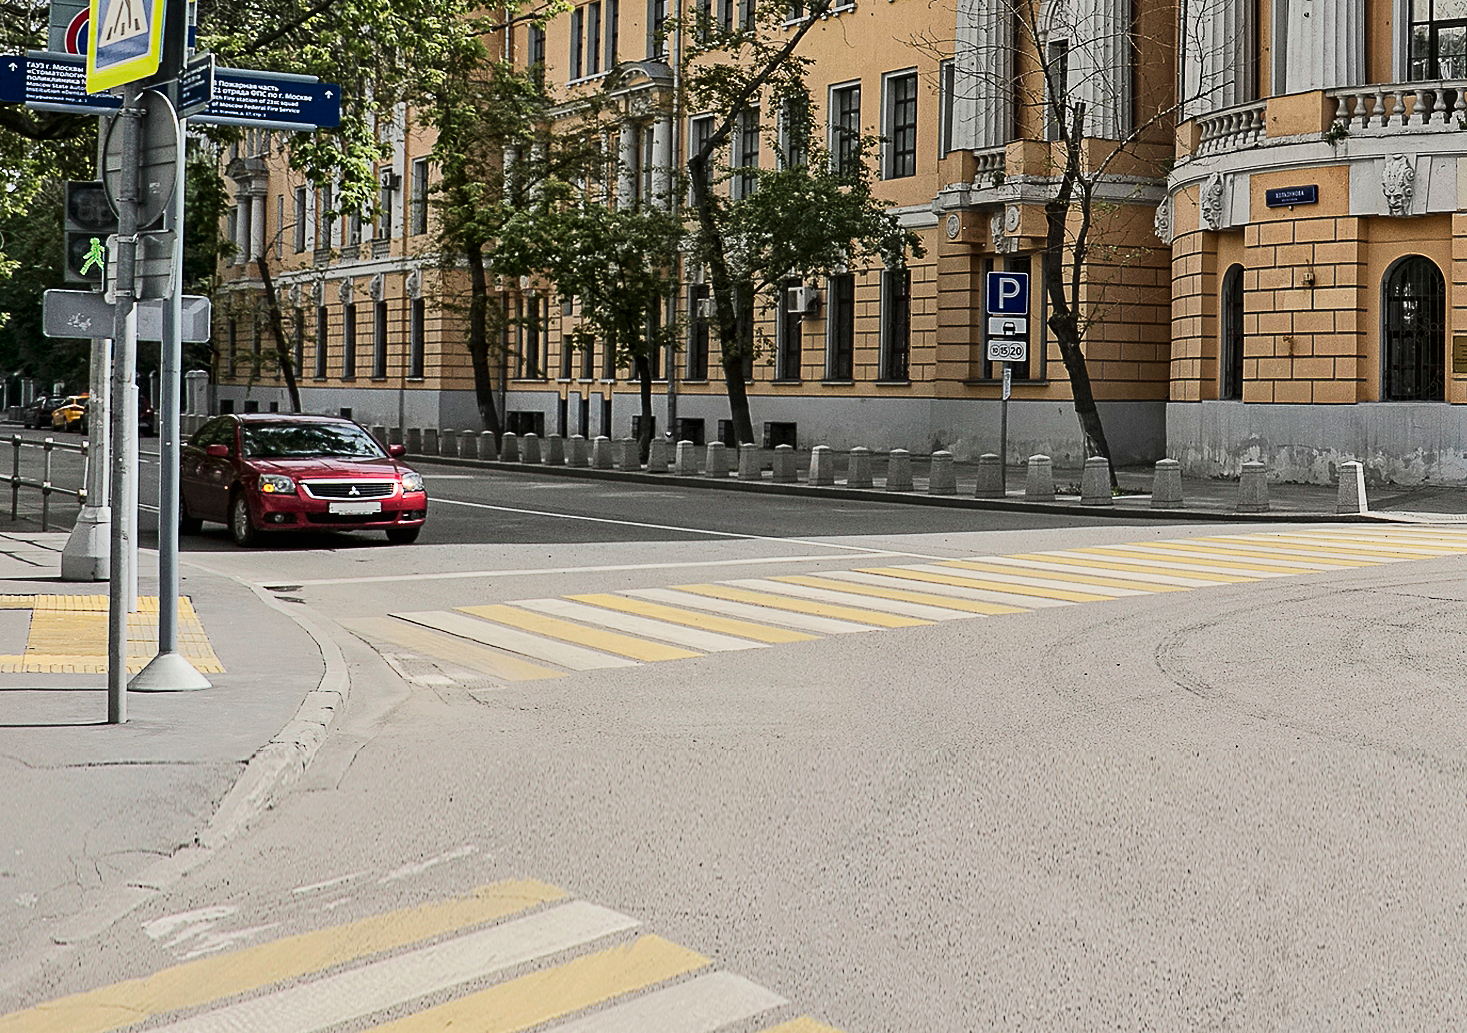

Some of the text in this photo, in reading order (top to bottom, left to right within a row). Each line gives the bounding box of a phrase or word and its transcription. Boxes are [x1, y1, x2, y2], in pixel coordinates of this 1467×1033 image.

[26, 61, 44, 69] ГАУЗ
[52, 64, 84, 72] Москвы
[218, 80, 257, 89] Пожарная
[257, 84, 280, 92] часть
[222, 88, 250, 96] отряда
[285, 93, 313, 102] Москве
[998, 277, 1020, 309] P
[999, 346, 1007, 355] 15
[1009, 346, 1022, 356] 20
